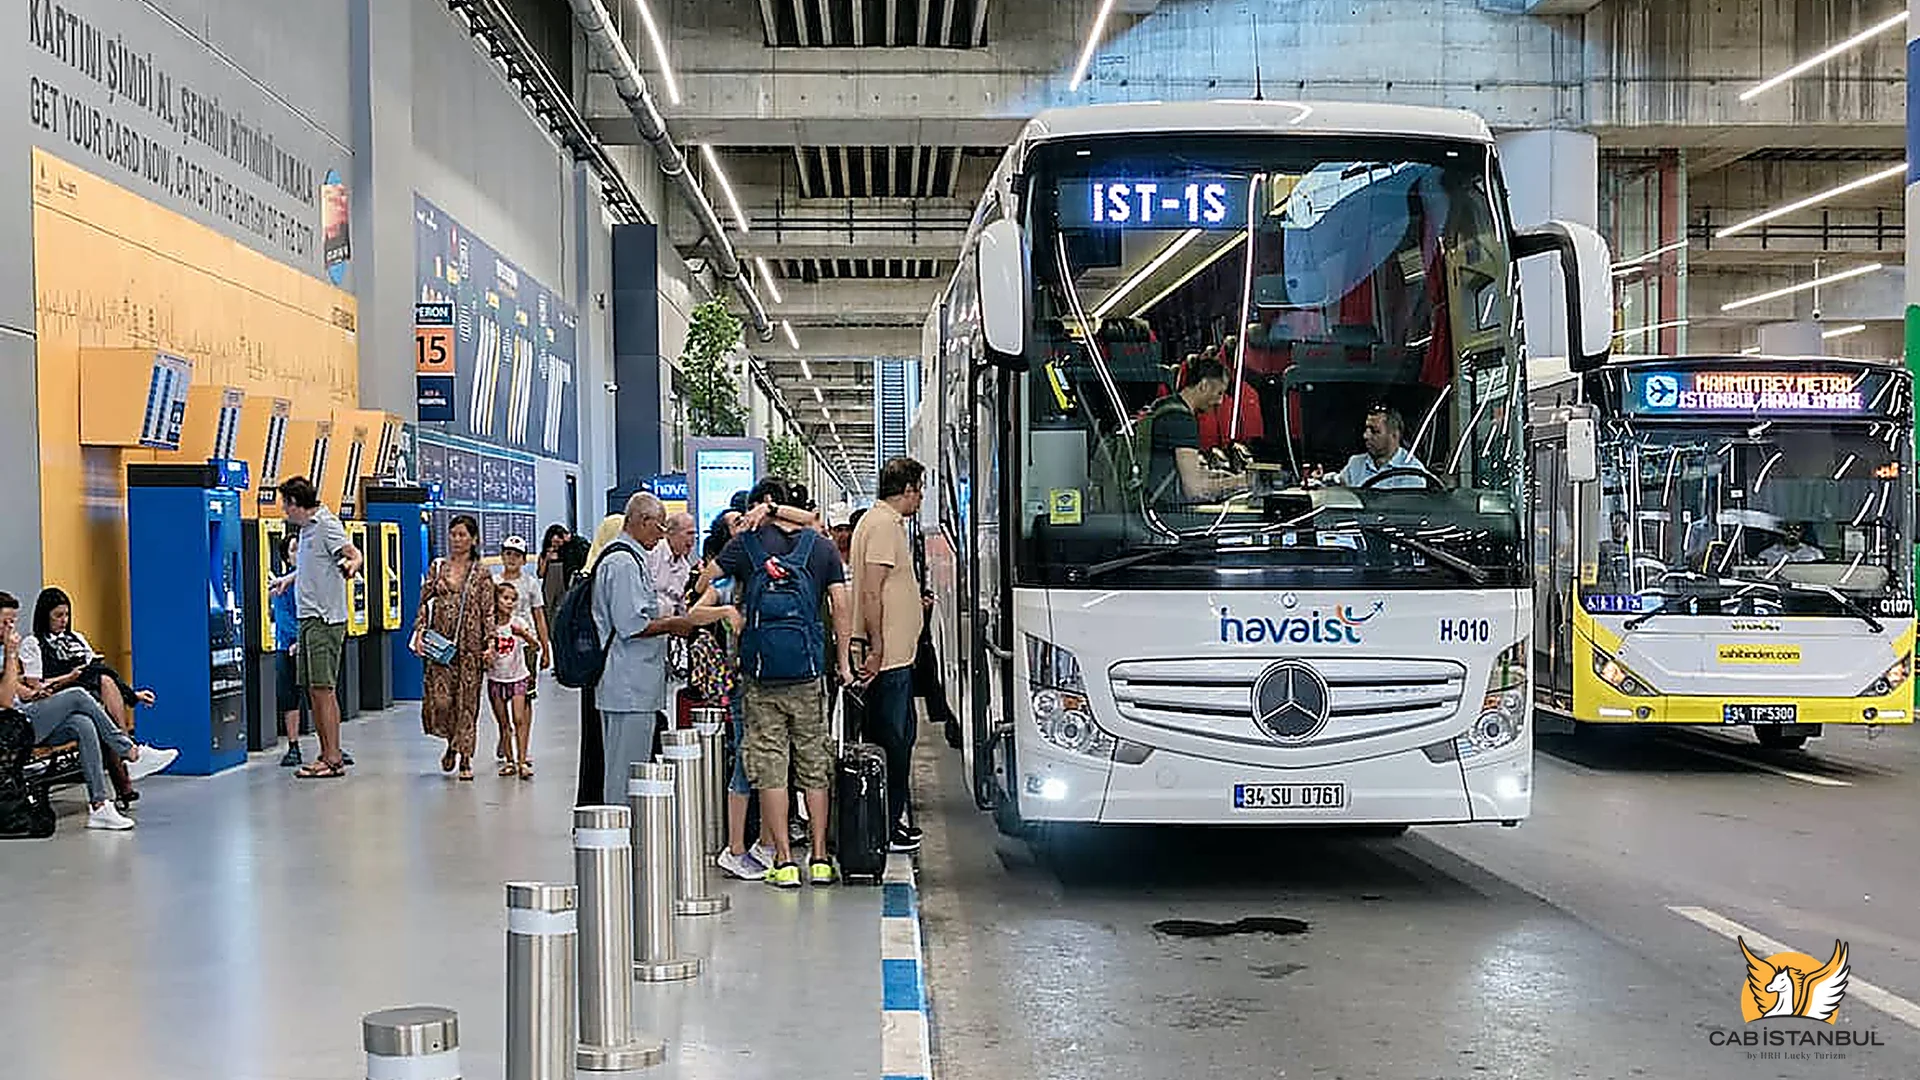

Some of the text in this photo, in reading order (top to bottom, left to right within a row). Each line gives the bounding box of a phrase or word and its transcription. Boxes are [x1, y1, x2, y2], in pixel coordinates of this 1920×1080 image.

[31, 77, 58, 132] GET
[63, 93, 101, 157] YOUR
[106, 118, 139, 173] CARD
[416, 335, 446, 364] 15
[1796, 375, 1853, 392] METRO
[1245, 786, 1340, 805] 34 SU 0761
